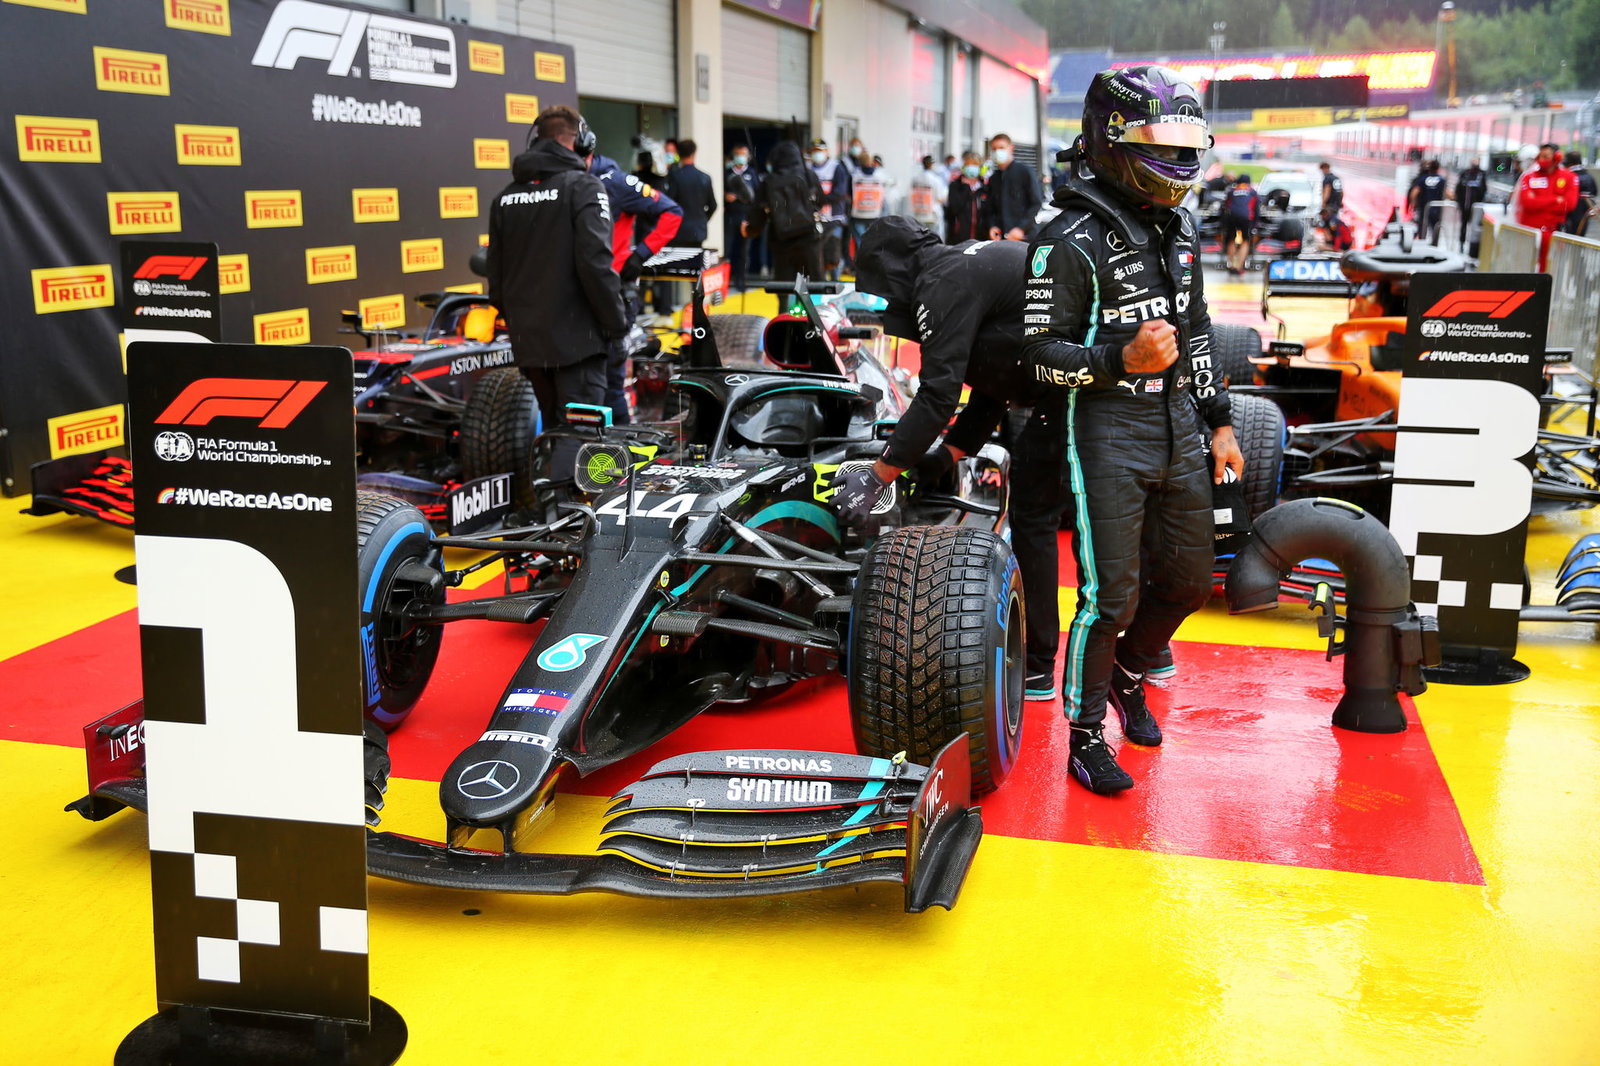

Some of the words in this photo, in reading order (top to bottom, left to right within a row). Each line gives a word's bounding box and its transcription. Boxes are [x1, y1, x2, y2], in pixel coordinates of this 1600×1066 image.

[102, 57, 162, 87] PIRELLI
[312, 93, 421, 127] #WeRaceAsOne
[25, 126, 92, 154] PIRELLI
[183, 134, 234, 158] PIRELLI
[252, 198, 297, 221] PIRELLI
[358, 196, 394, 216] PIRELLI
[501, 188, 559, 207] PETRONAS
[115, 201, 174, 225] PIRELLI
[219, 263, 243, 286] ELLI
[312, 254, 351, 276] PIRELLI
[1124, 261, 1144, 276] UBS
[41, 274, 106, 304] PIRELLI
[1026, 289, 1052, 299] EPSON
[261, 317, 305, 342] PIRELLI
[450, 355, 480, 376] ASTON
[1189, 333, 1216, 399] INEOS
[1430, 351, 1530, 363] #WeRaceAsOne
[1035, 364, 1094, 388] INEOS
[57, 414, 119, 450] PIRELLI
[197, 438, 217, 450] FIA
[219, 439, 268, 452] Formula
[270, 441, 278, 452] 1
[1389, 377, 1541, 536] 3
[197, 450, 233, 462] World
[235, 452, 322, 466] Championship
[175, 488, 332, 512] #WeRaceAsOne
[453, 482, 491, 526] Mobil
[595, 490, 700, 529] 44
[135, 535, 365, 827] 1
[517, 688, 568, 697] TOMMY
[505, 706, 557, 716] HILFIGER
[725, 756, 833, 772] PETRONAS
[727, 778, 832, 803] SYNTIUM
